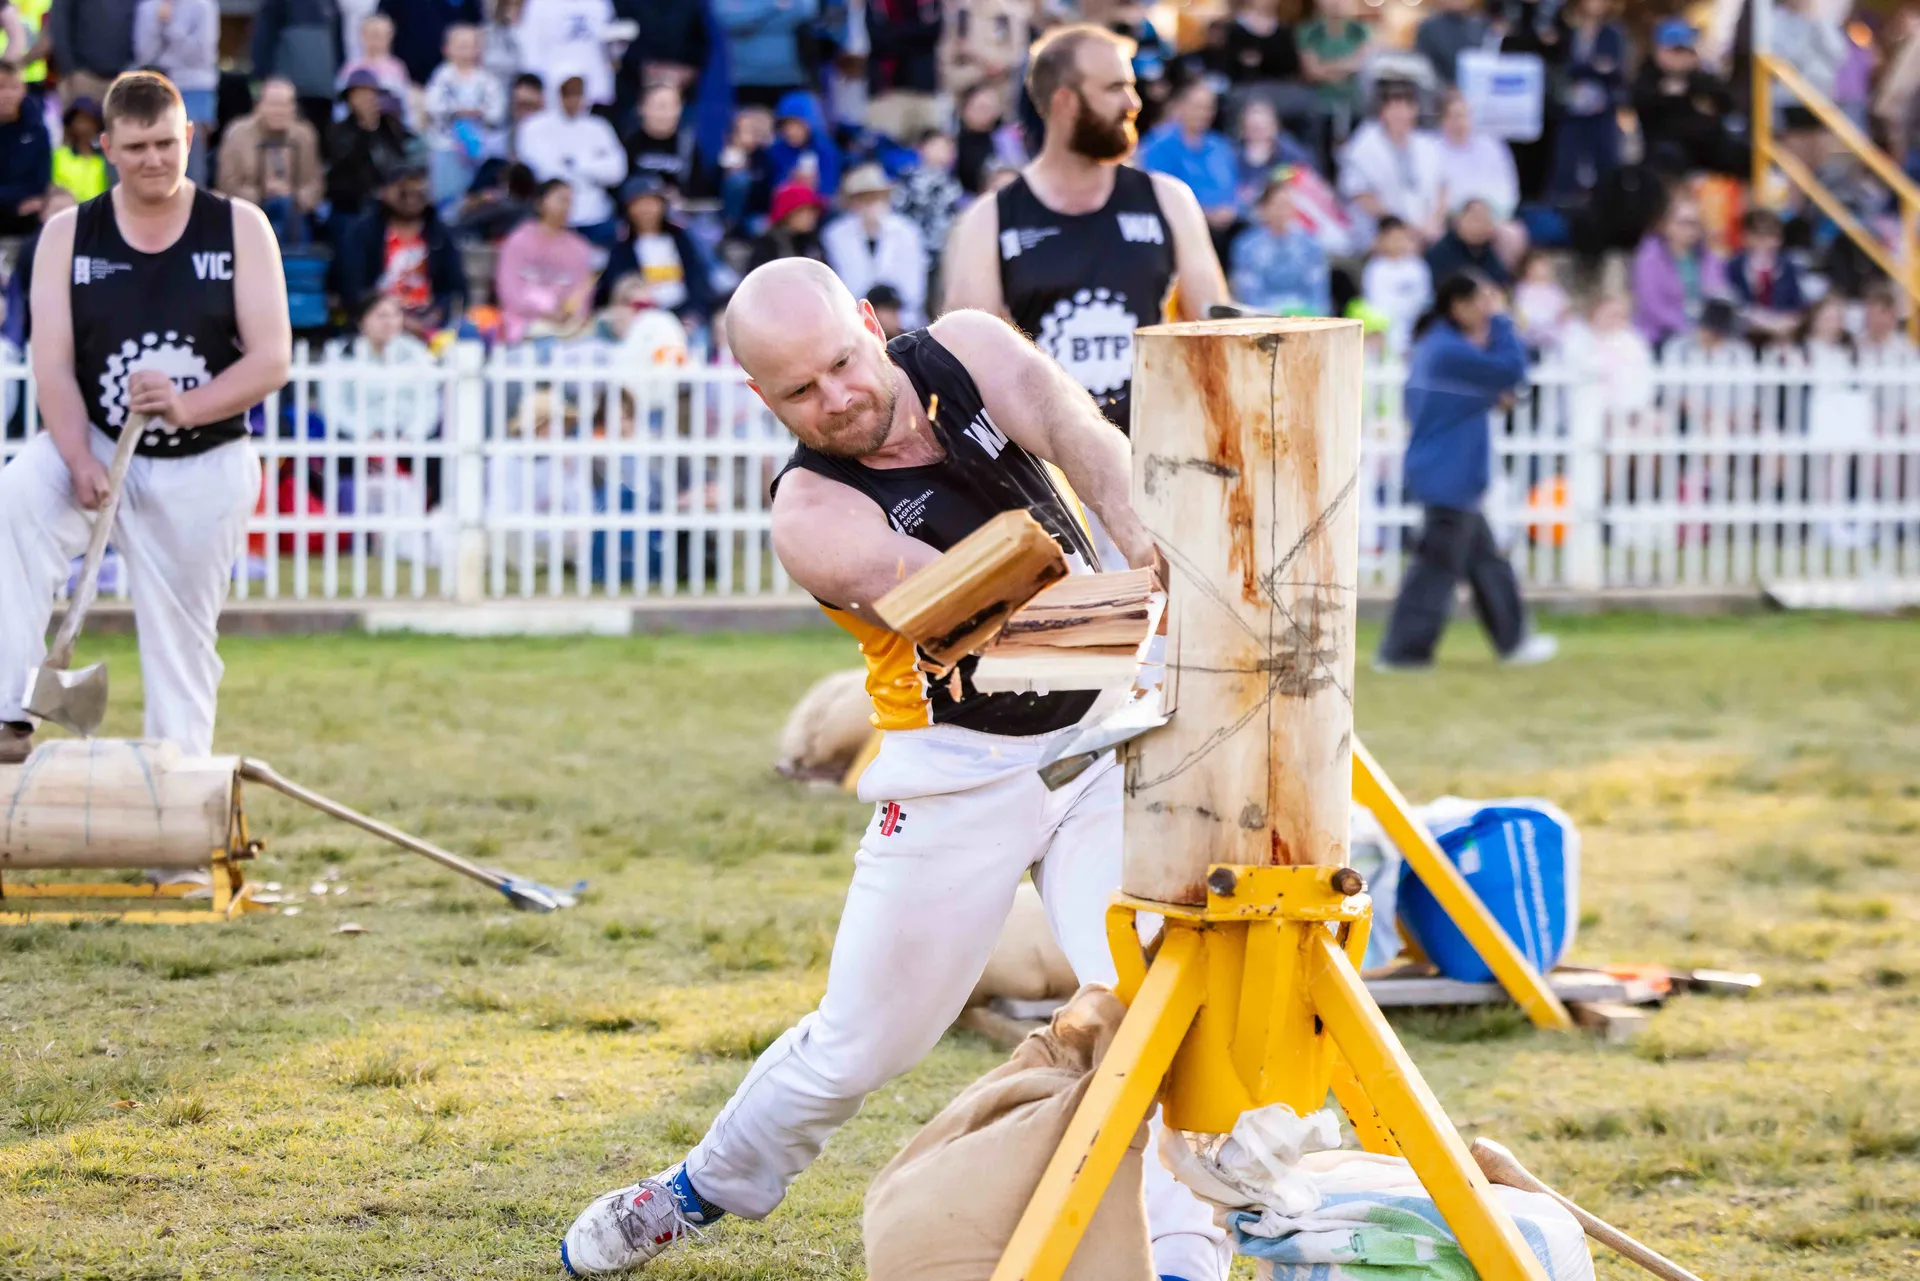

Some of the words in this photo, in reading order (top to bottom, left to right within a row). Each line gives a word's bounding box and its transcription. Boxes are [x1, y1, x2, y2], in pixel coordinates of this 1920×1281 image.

[191, 252, 233, 280] VIC
[1072, 336, 1131, 362] BTP
[892, 498, 911, 515] ROYAL
[898, 489, 934, 521] AGRICULTURAL
[902, 504, 926, 528] SOCIETY
[912, 517, 924, 527] WA
